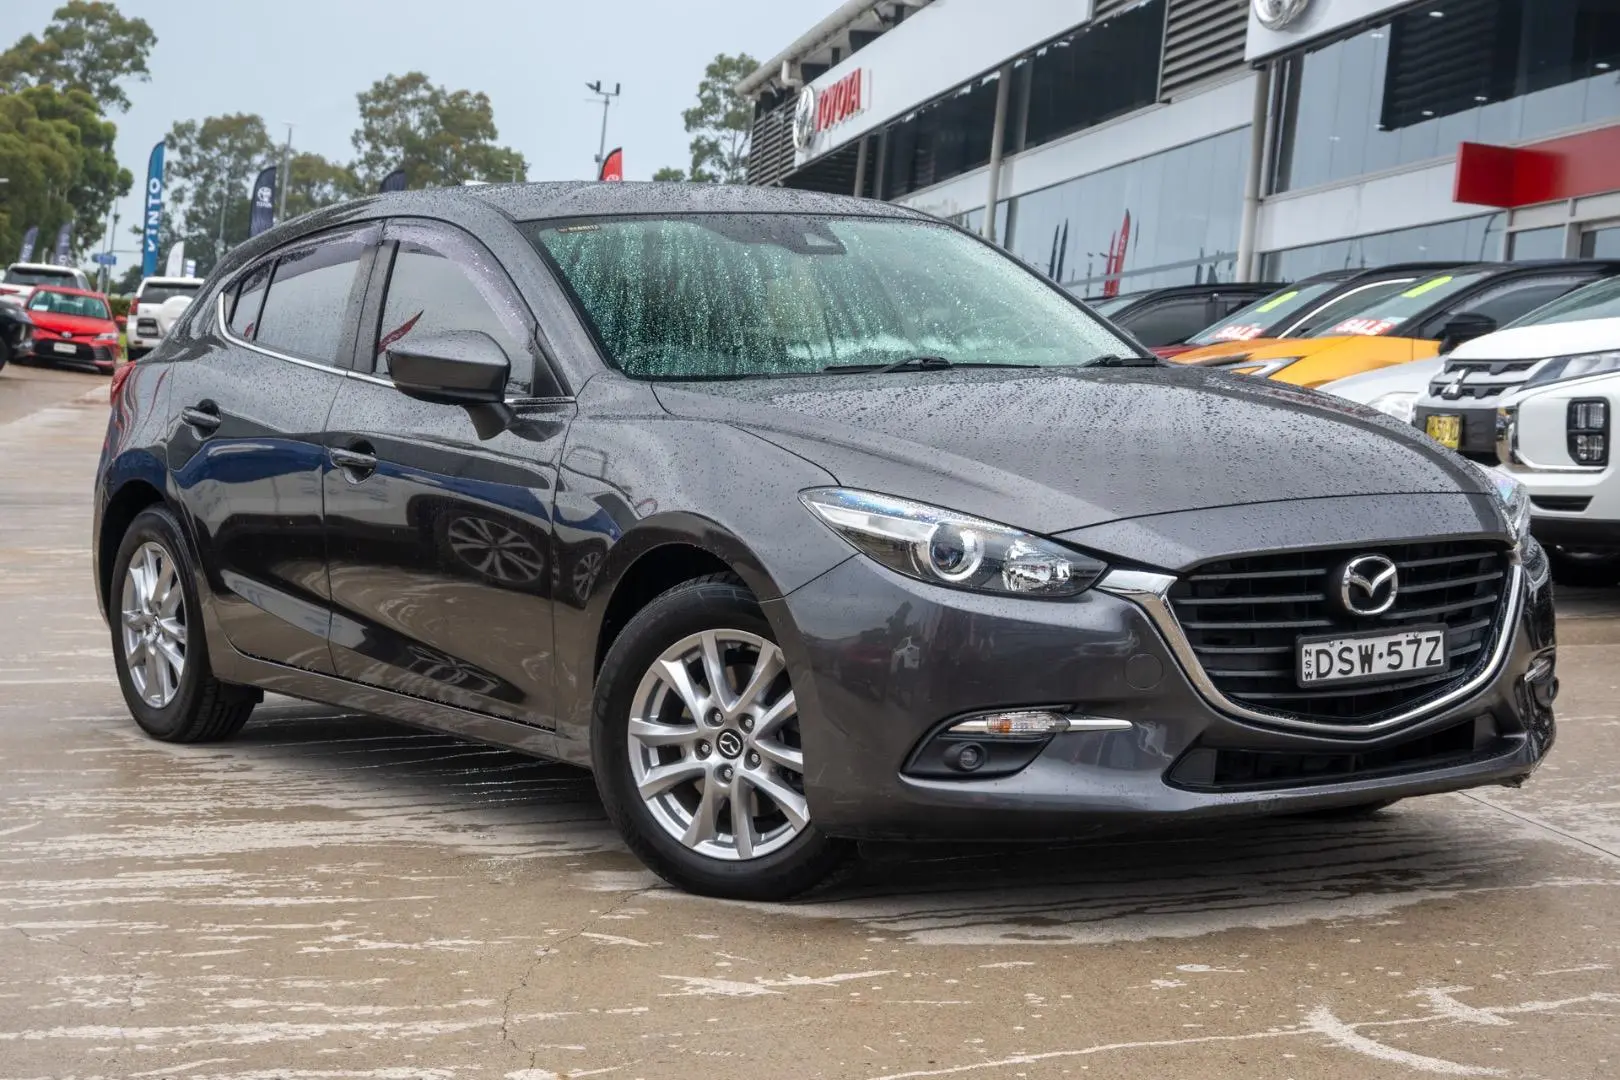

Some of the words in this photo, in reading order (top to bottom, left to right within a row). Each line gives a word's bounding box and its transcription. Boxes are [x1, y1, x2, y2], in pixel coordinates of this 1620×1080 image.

[816, 68, 861, 132] TOYOTA
[1215, 325, 1263, 340] SALE
[1336, 319, 1393, 335] SALE
[1304, 649, 1314, 679] NSW
